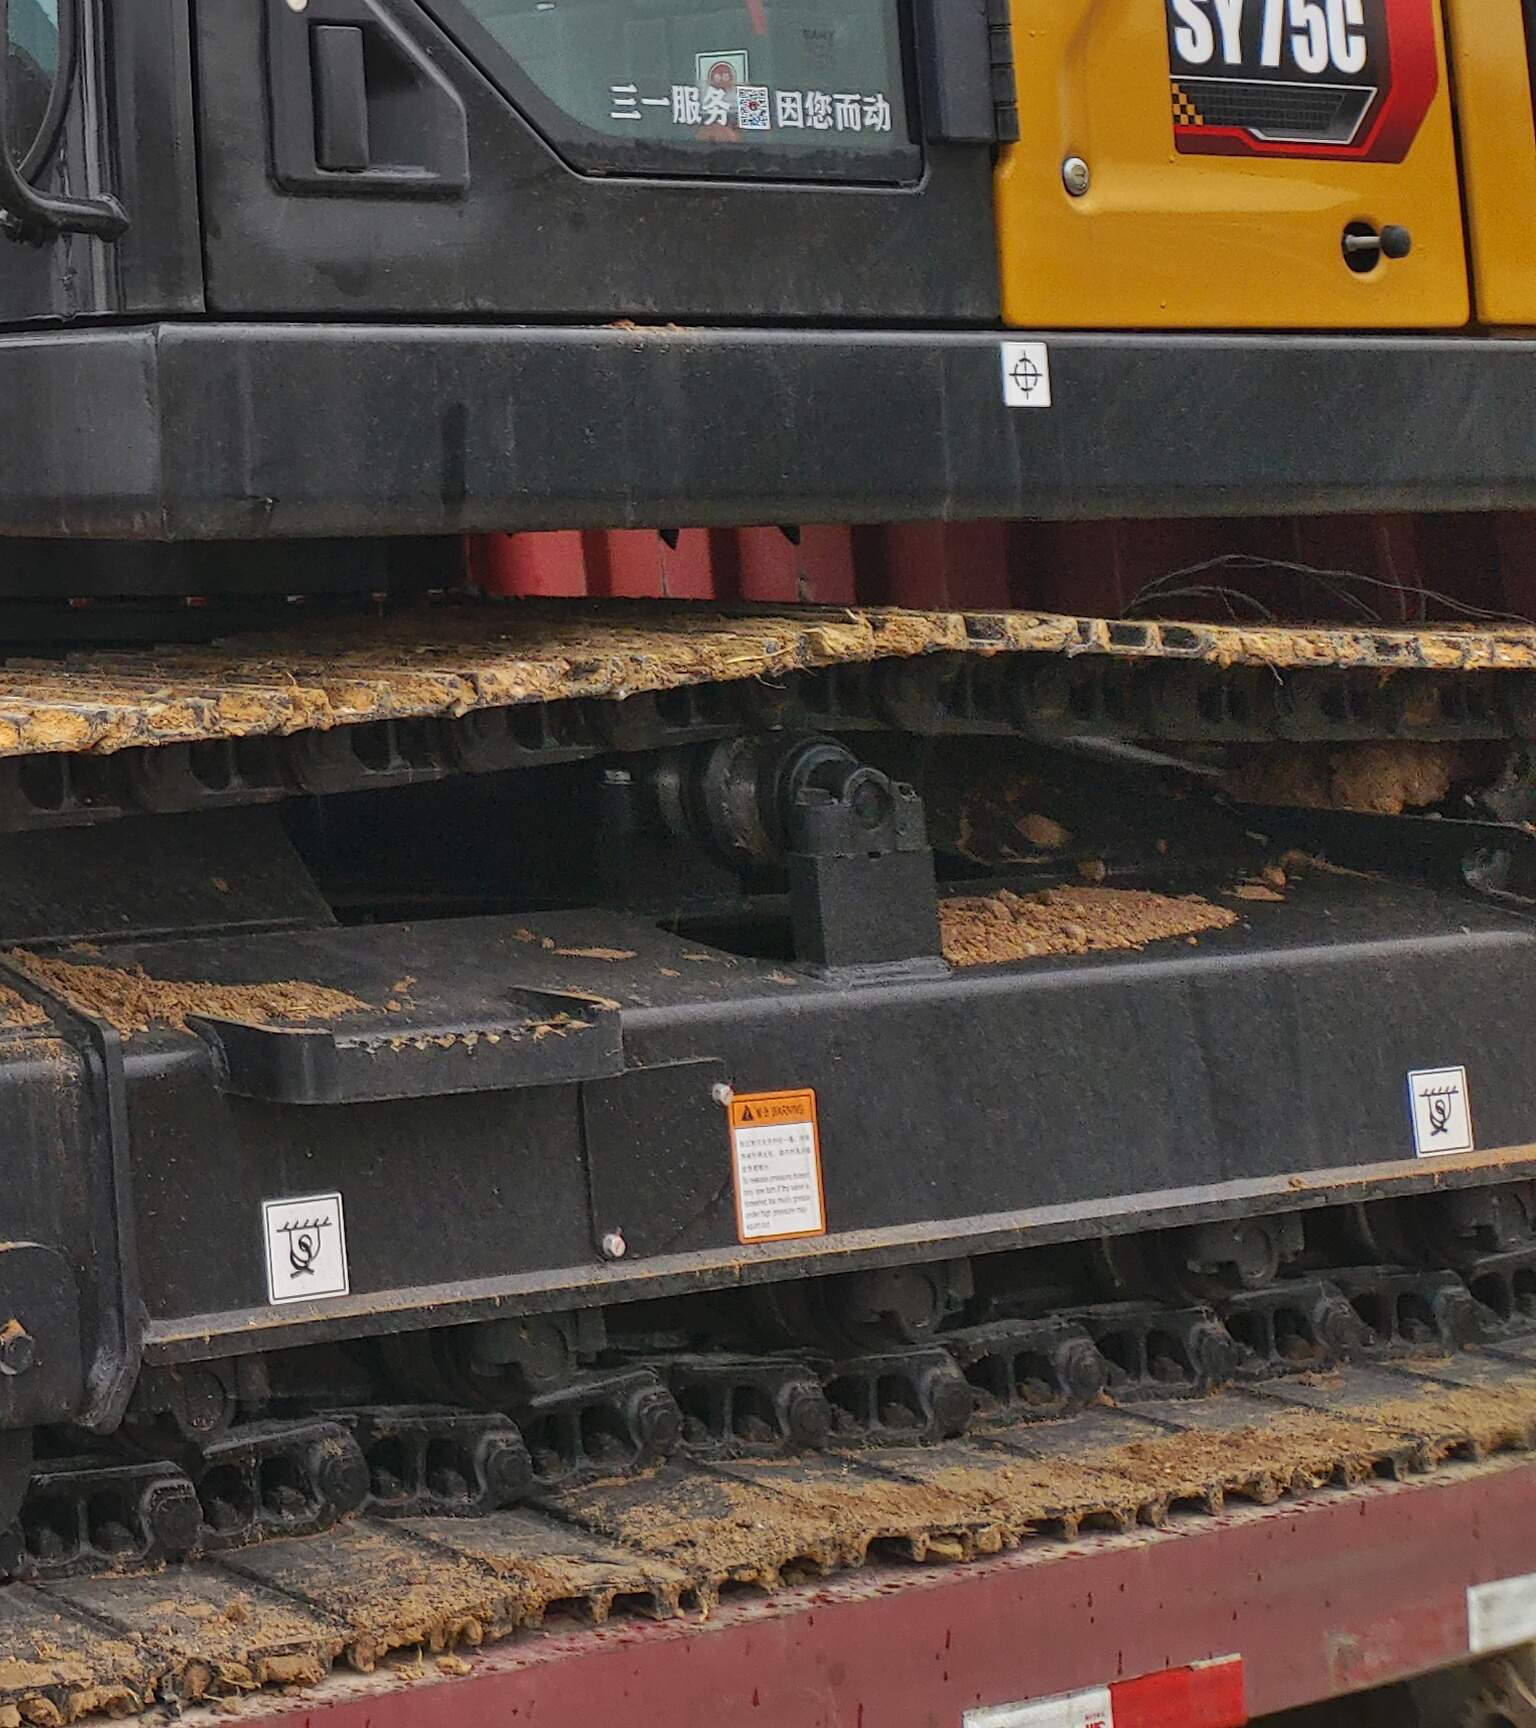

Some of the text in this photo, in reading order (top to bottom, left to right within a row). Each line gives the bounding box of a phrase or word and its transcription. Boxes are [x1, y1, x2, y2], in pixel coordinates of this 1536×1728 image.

[609, 83, 892, 133] 三一服务 因您而动
